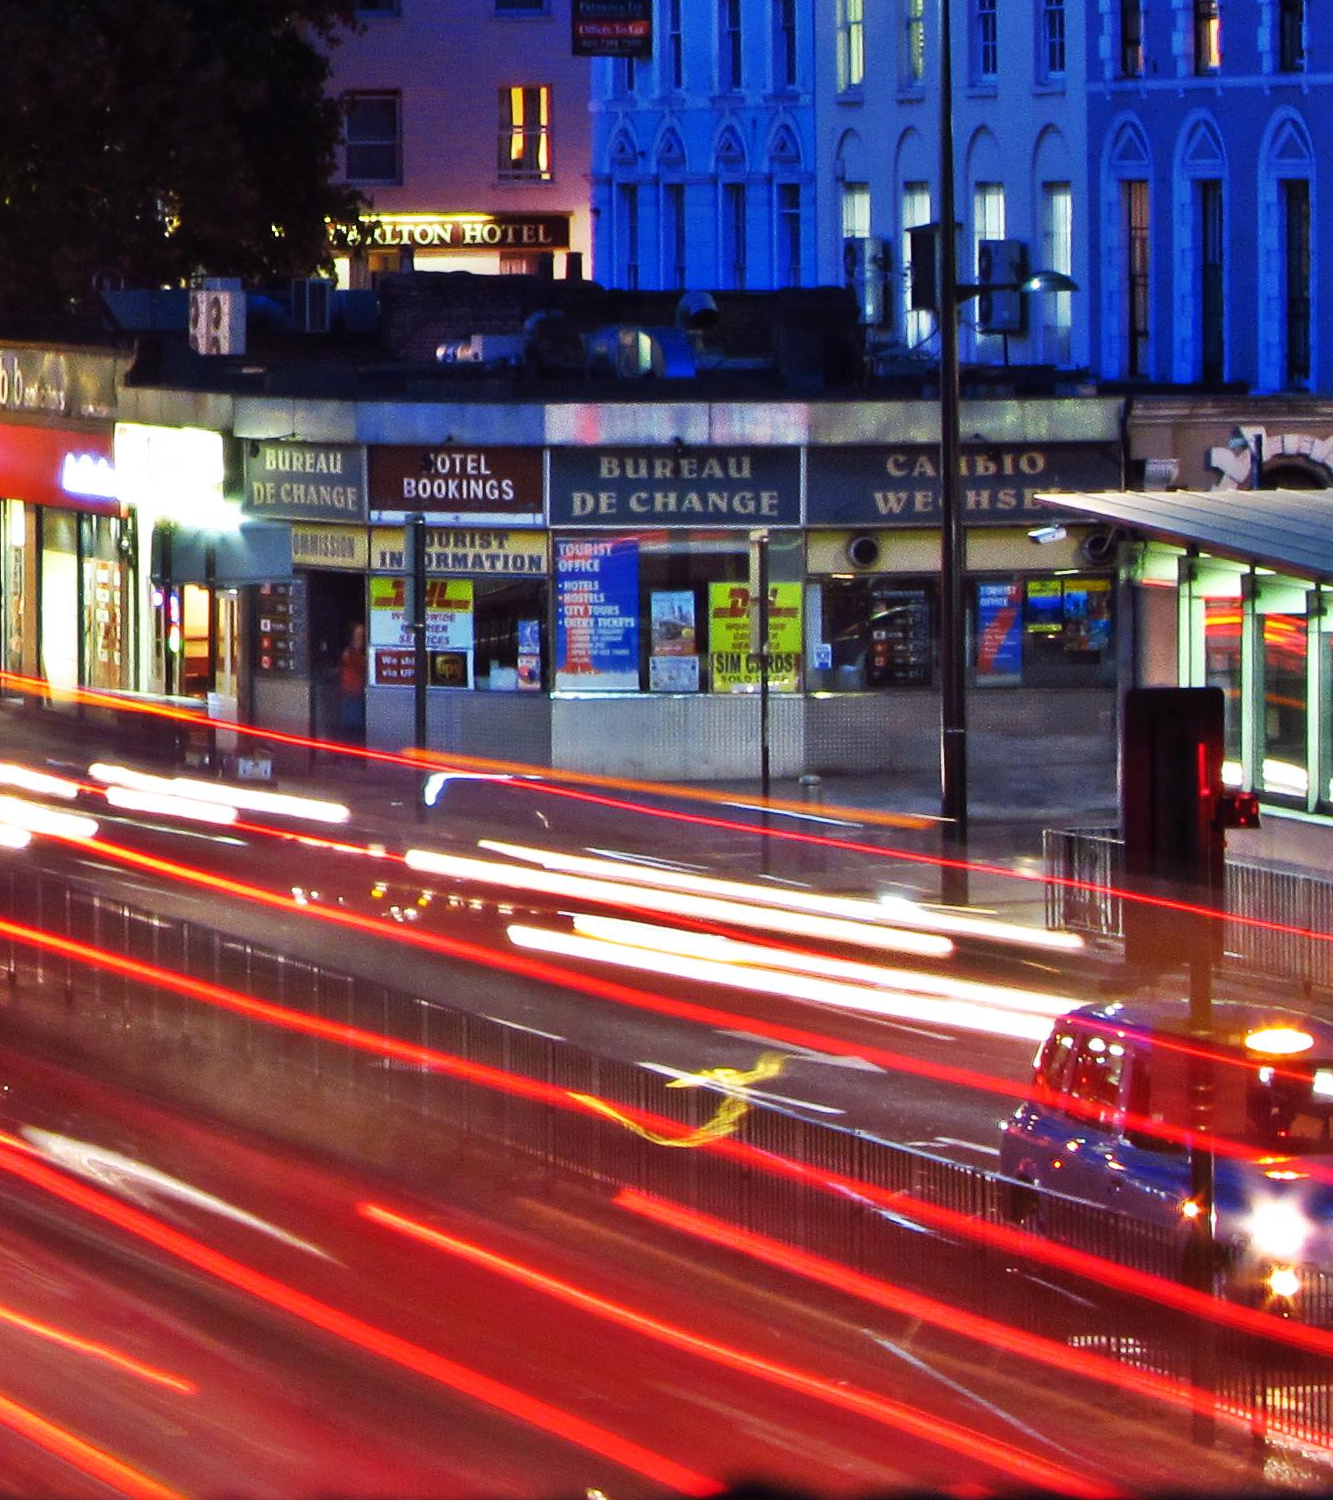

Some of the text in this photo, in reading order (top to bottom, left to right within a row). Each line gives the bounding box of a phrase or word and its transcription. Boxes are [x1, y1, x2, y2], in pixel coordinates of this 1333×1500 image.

[462, 222, 553, 245] HOTEL
[265, 448, 342, 474] BUREAU
[425, 453, 492, 475] OTEL
[599, 456, 752, 479] BUREAU
[253, 481, 358, 511] DE CHANGE
[403, 477, 515, 500] BOOKINGS
[571, 491, 779, 516] DE CHANGE
[873, 485, 1061, 515] WEHSE
[426, 530, 508, 549] OURIST
[558, 543, 613, 557] TOURIST
[379, 551, 542, 571] INORMATION
[558, 559, 600, 573] OFFICE
[400, 668, 415, 678] UP
[715, 652, 794, 673] SIM CRDS
